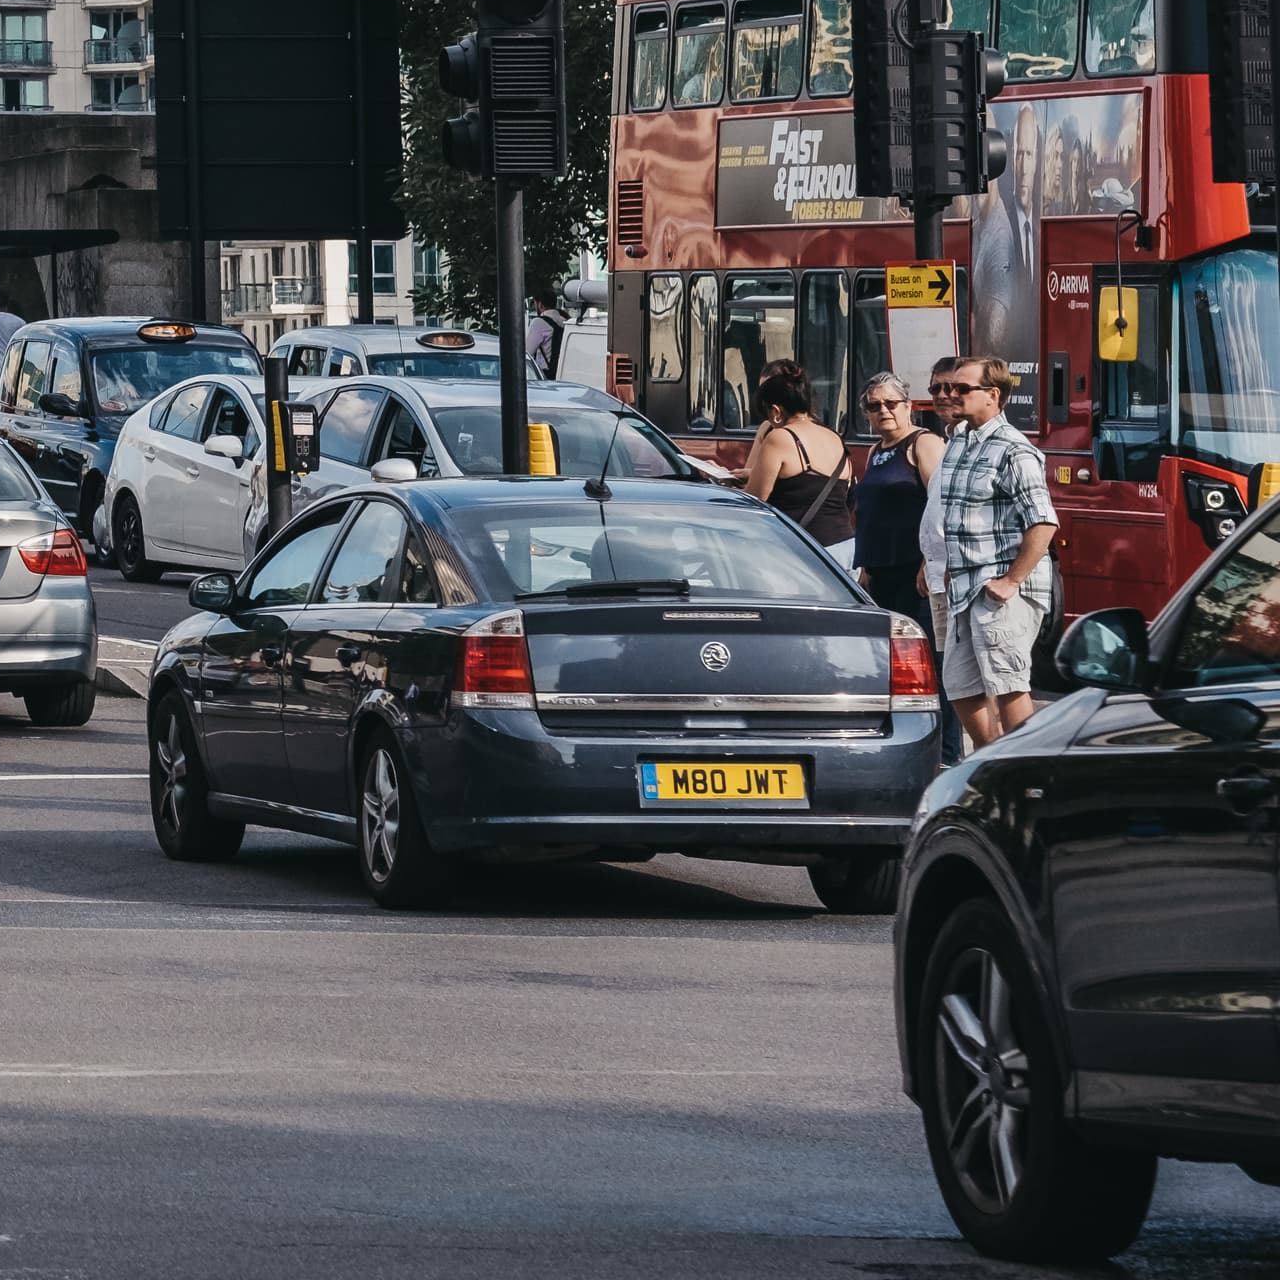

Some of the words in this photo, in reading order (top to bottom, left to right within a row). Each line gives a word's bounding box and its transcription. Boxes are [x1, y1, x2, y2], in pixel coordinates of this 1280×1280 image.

[769, 120, 823, 165] FAST
[785, 164, 858, 211] FURIOU
[891, 275, 910, 284] Buses
[1059, 275, 1089, 294] ARRIVA
[891, 288, 923, 298] Diversion
[1009, 362, 1034, 374] AUGUST
[1139, 484, 1158, 497] HV294
[551, 697, 596, 705] VECTRA
[672, 769, 727, 795] M80
[737, 769, 788, 795] JWT
